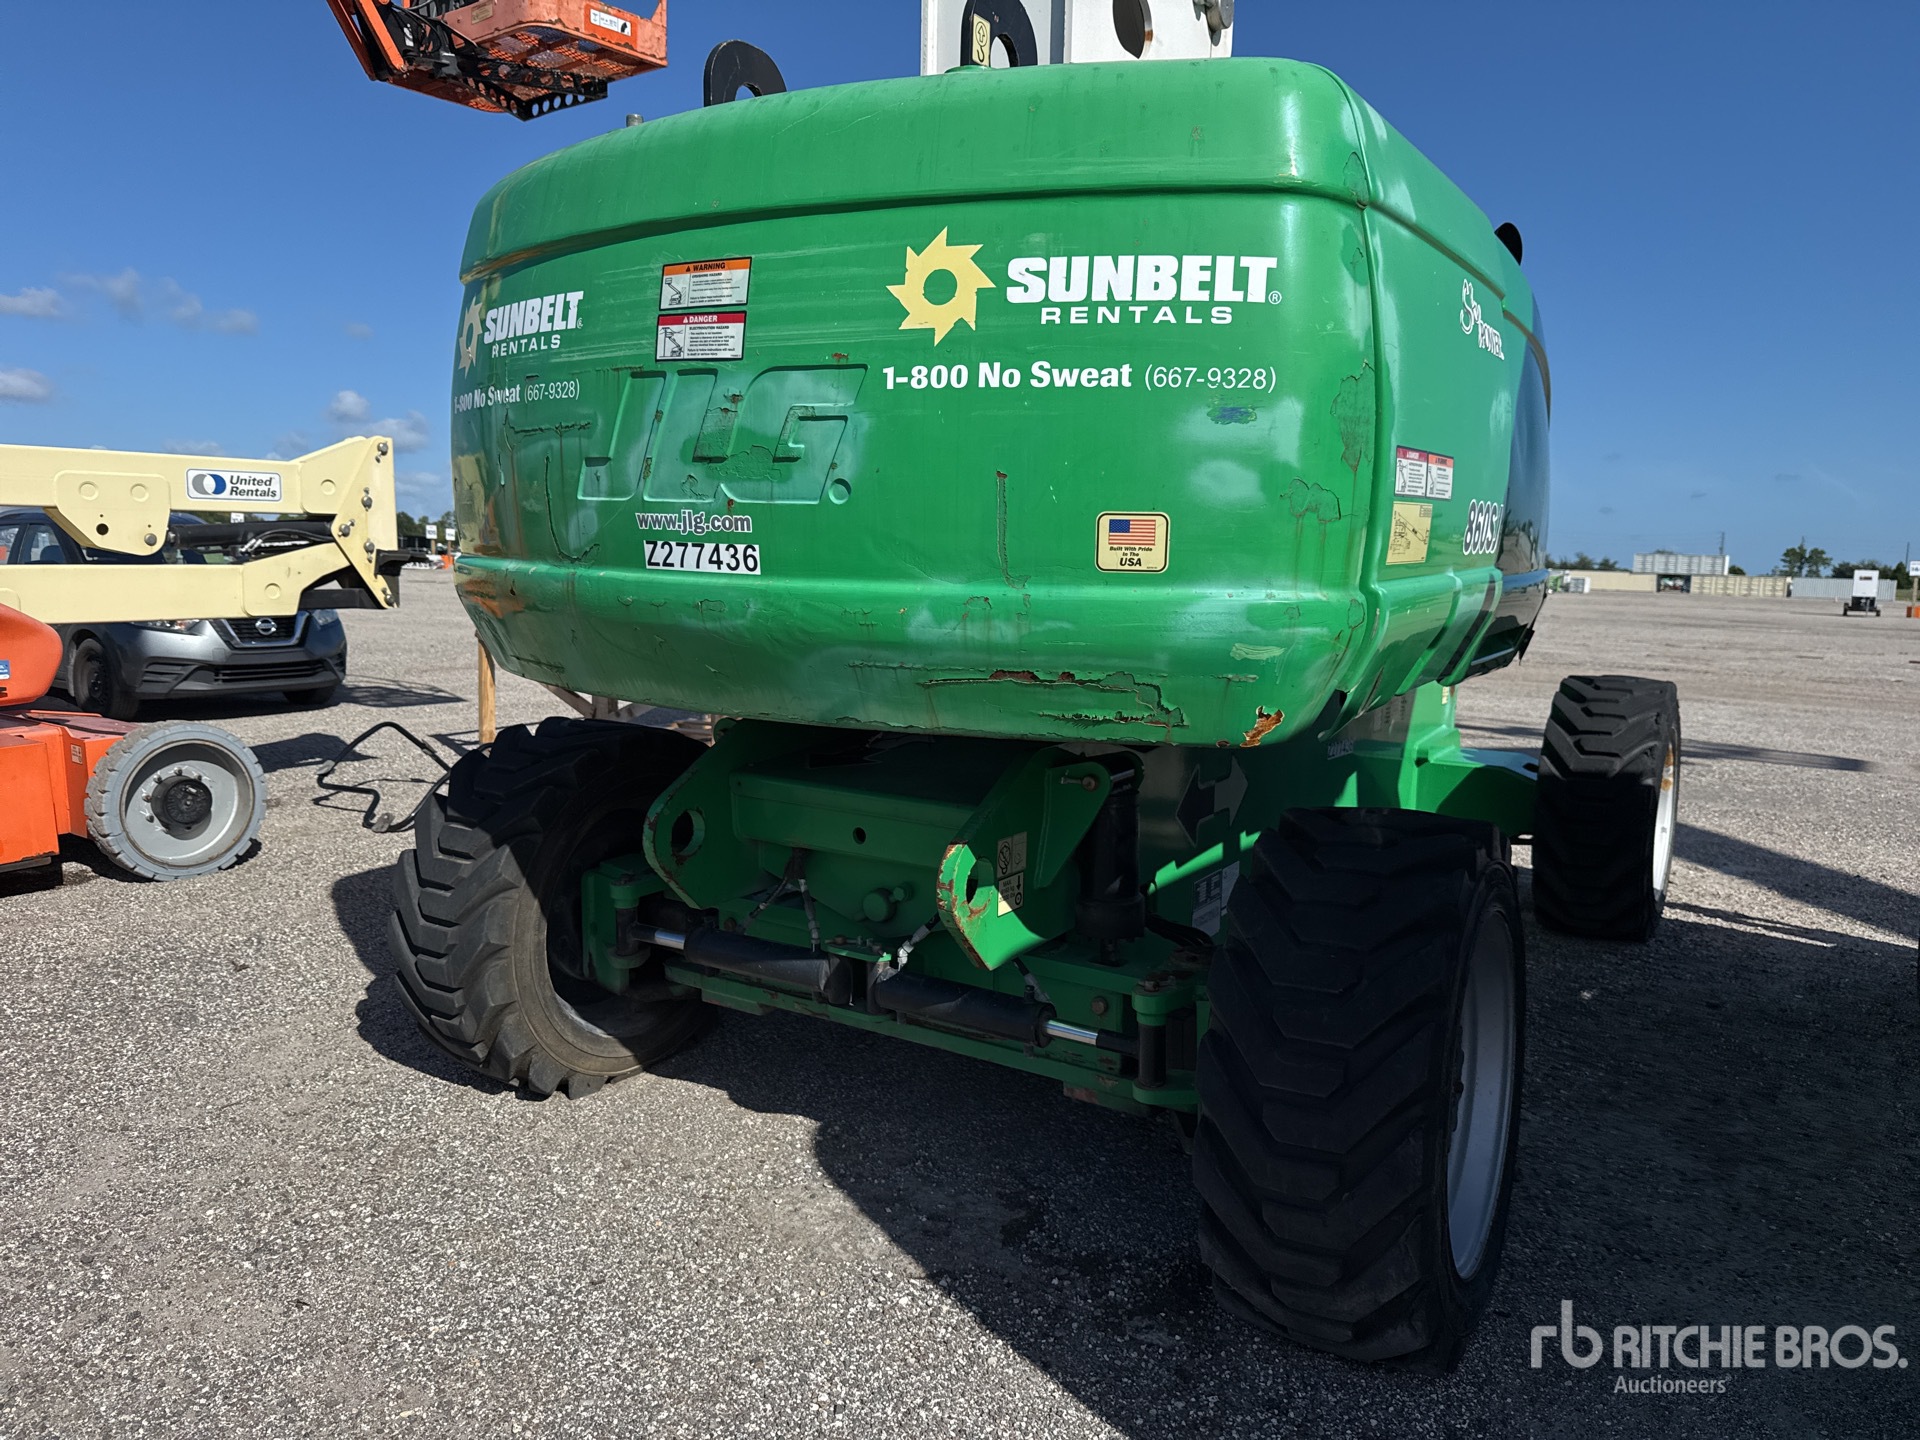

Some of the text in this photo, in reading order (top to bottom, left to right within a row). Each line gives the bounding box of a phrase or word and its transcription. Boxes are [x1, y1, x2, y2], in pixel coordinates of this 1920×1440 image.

[693, 262, 725, 271] WARNING
[689, 314, 718, 323] DANGER
[1040, 306, 1233, 325] RENTALS
[491, 334, 561, 359] RENTALS
[882, 360, 1277, 394] 1-800 No Sweat (667-9328)
[473, 387, 486, 409] No
[487, 383, 521, 406] Sweat
[524, 378, 580, 404] (667-9328)
[229, 475, 273, 487] United
[229, 486, 277, 498] Rentals
[635, 509, 752, 535] www.jlg.com
[645, 540, 758, 572] Z277436
[1119, 557, 1142, 567] USA
